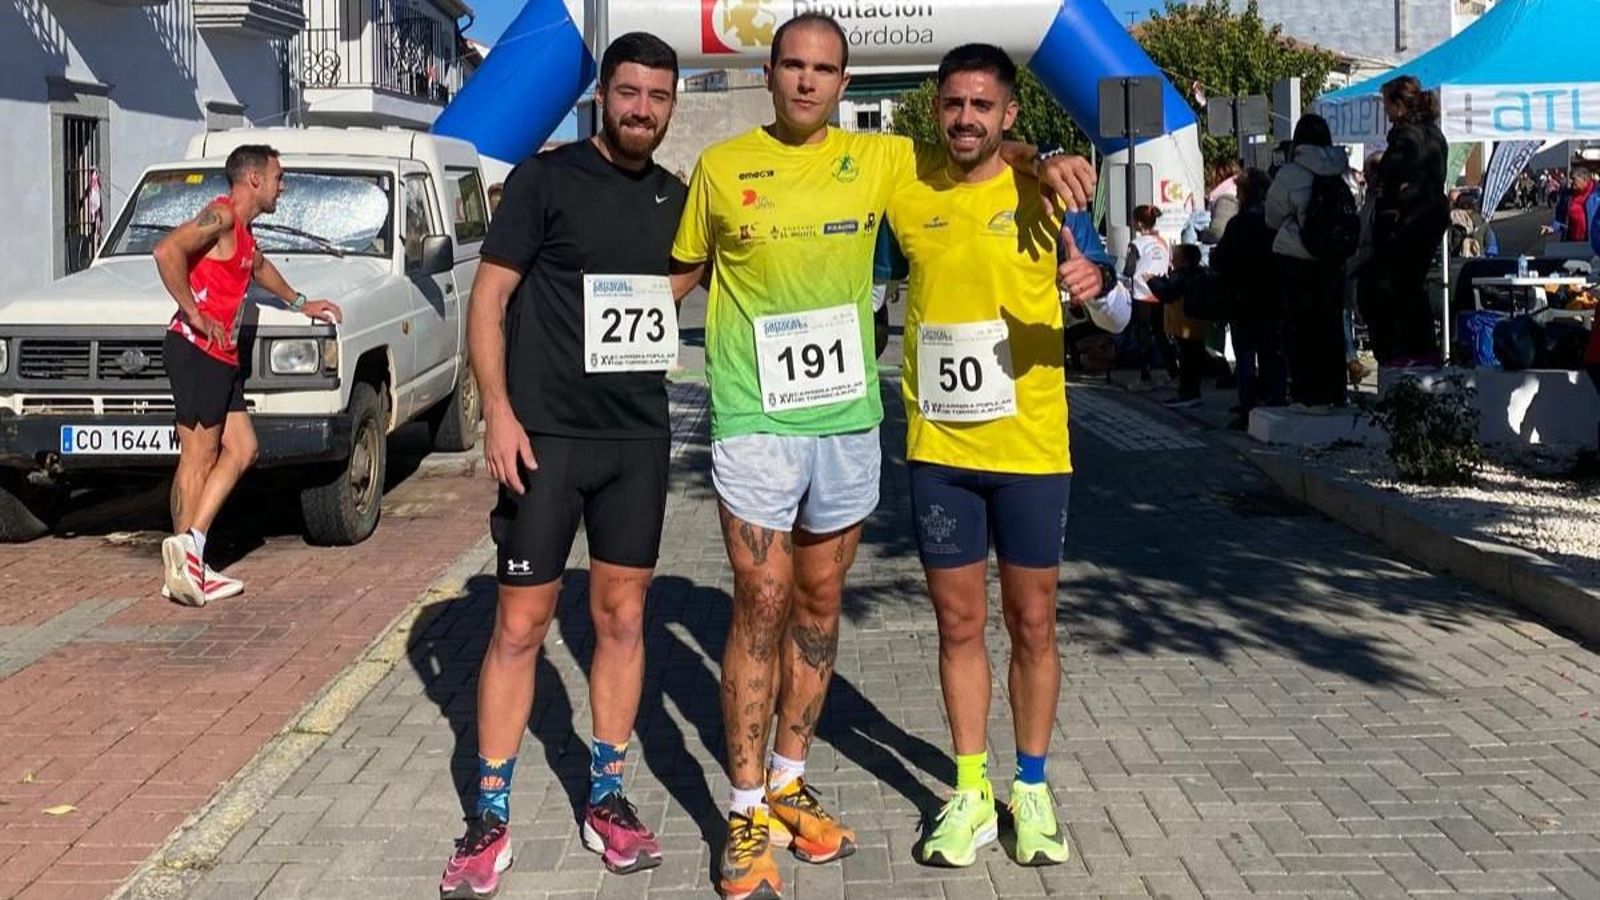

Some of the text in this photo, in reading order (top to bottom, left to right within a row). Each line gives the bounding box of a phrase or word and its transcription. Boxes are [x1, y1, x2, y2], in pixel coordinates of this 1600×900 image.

[843, 24, 933, 46] órdoba
[601, 307, 665, 343] 273
[778, 339, 844, 381] 191
[939, 356, 983, 393] 50
[779, 391, 794, 405] XVI
[76, 430, 102, 451] CO
[112, 430, 162, 451] 1644
